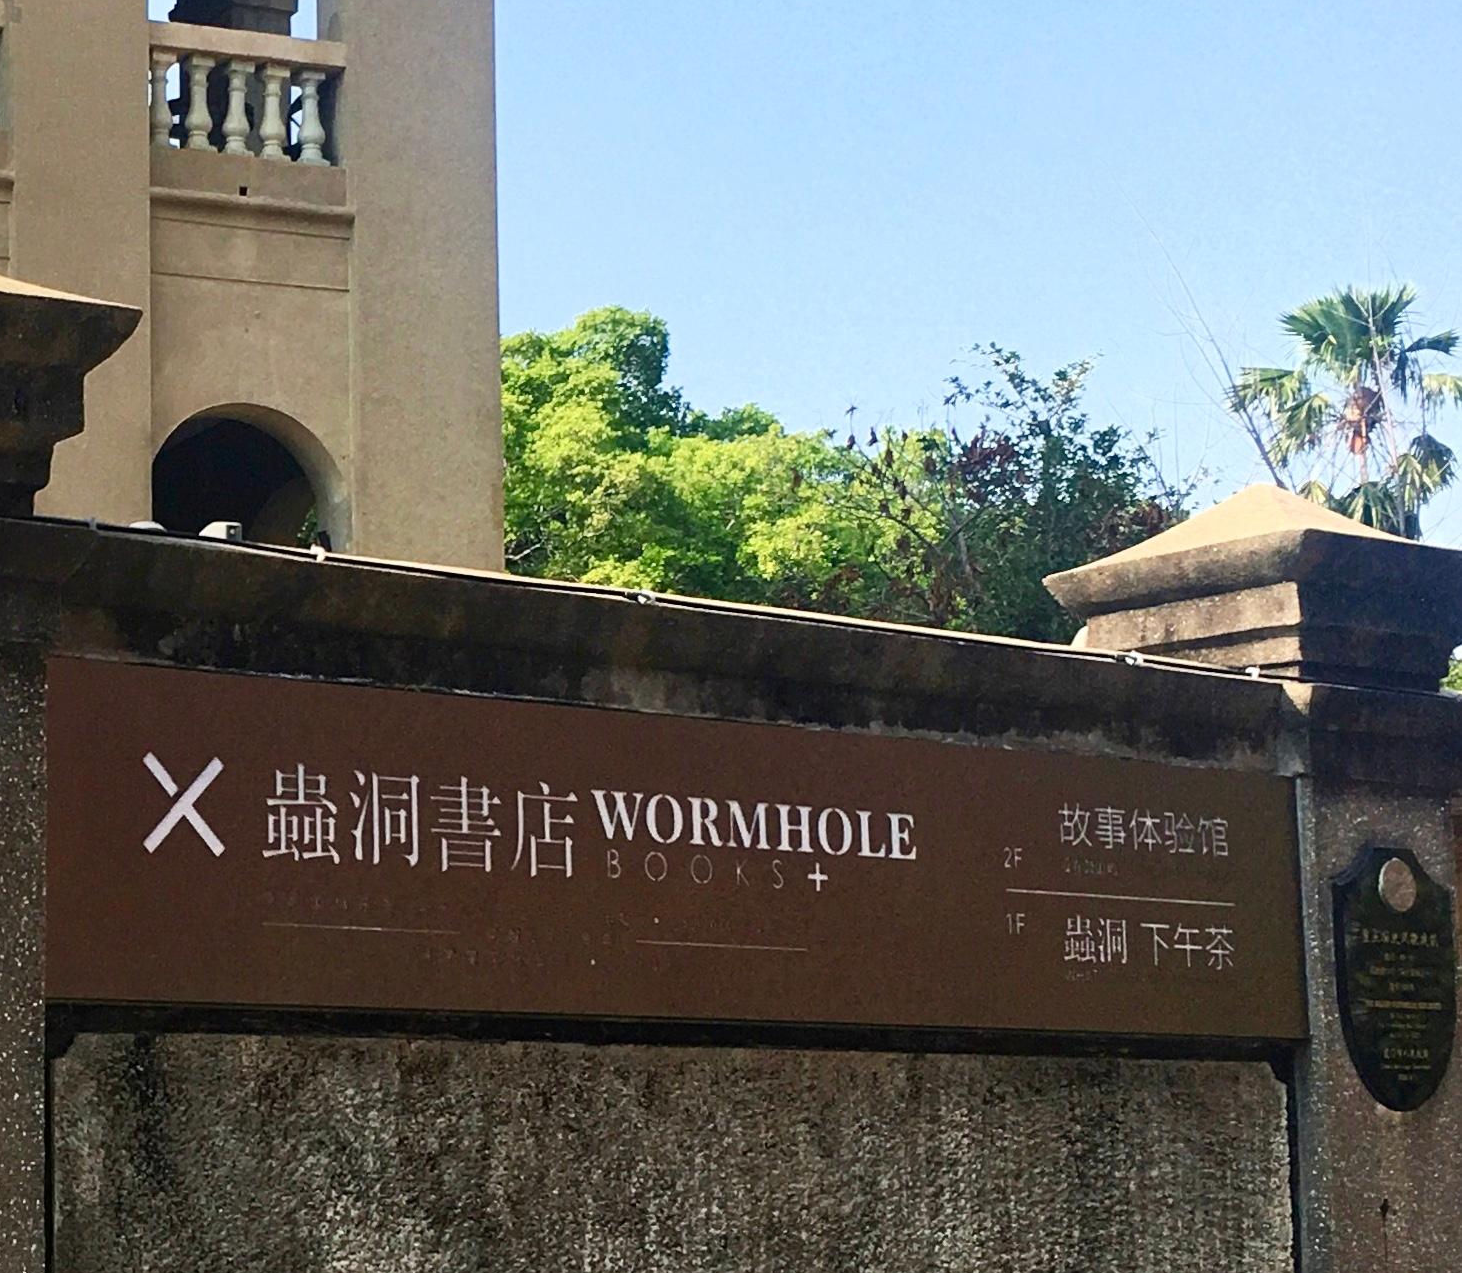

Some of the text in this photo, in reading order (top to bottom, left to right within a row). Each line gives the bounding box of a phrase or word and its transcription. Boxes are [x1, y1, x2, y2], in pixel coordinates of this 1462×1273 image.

[262, 763, 917, 878] 蟲洞書店 WORMHOLE
[1003, 847, 1022, 868] 2F
[1058, 803, 1229, 857] 故事体验馆
[1006, 913, 1235, 970] 1F 蟲洞 下午茶
